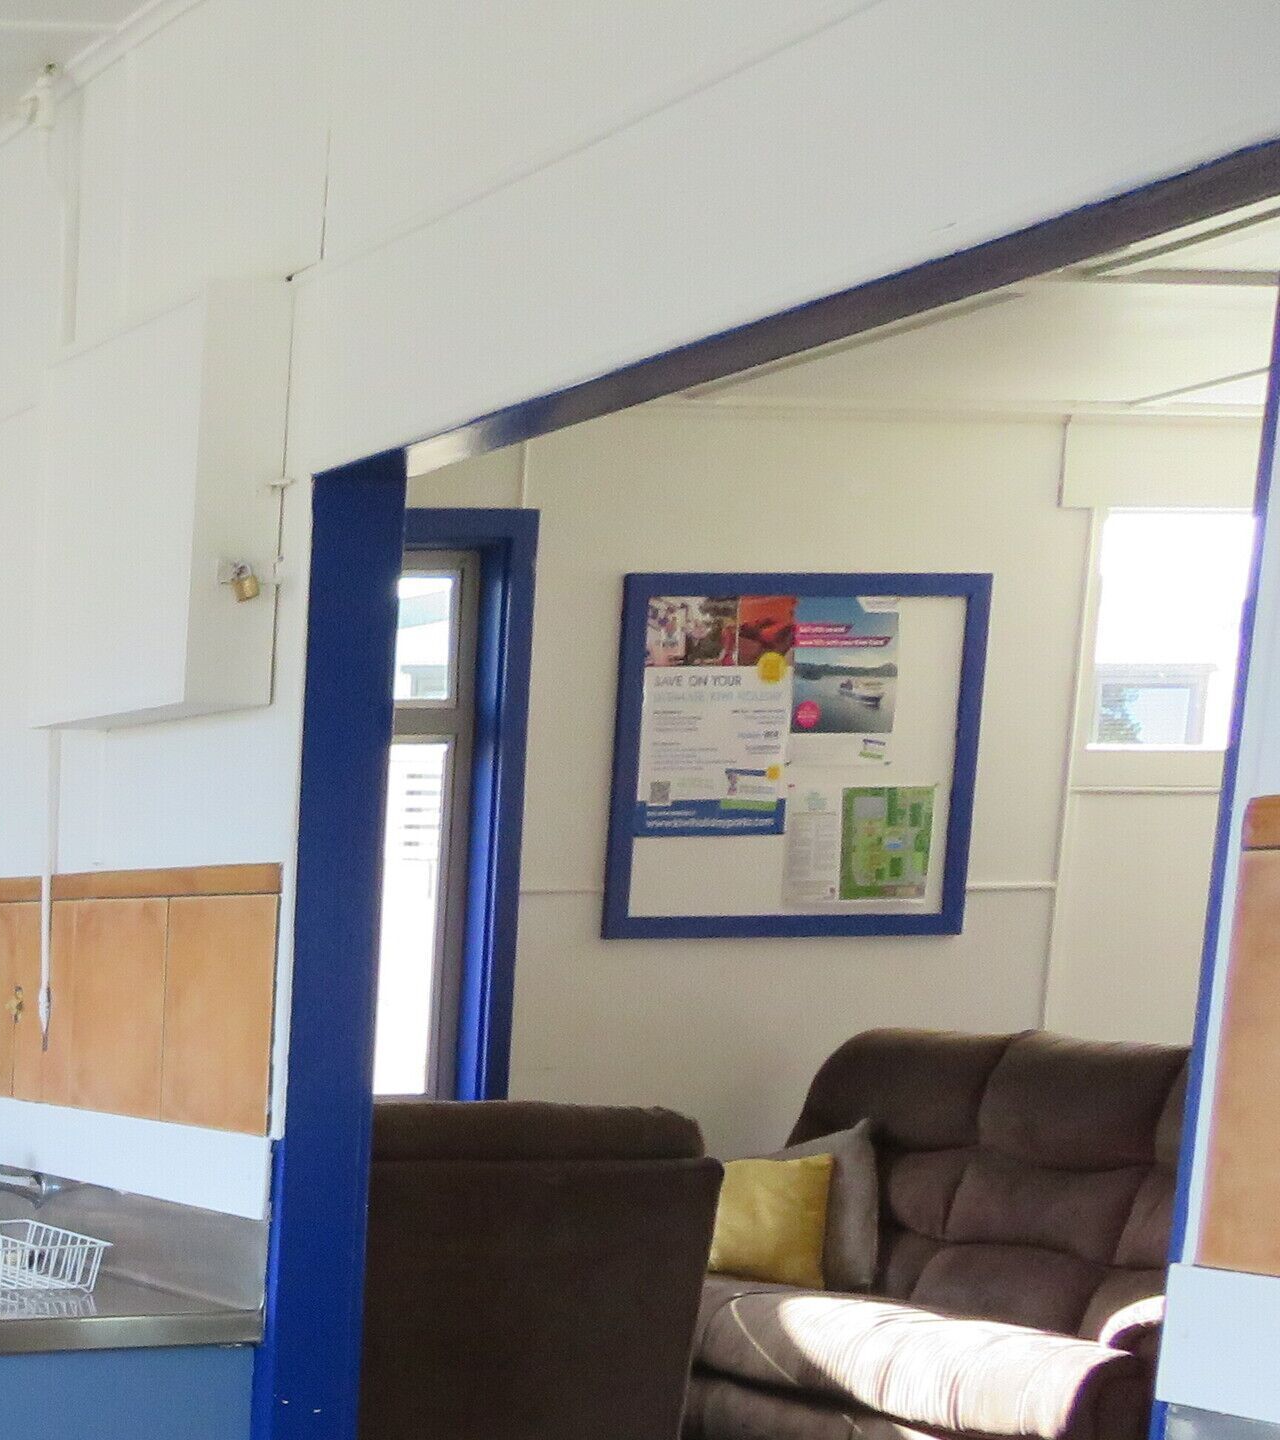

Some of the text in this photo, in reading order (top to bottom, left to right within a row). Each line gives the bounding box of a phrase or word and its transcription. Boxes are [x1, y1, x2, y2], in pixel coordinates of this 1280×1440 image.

[653, 674, 742, 687] SAVE ON YOUR
